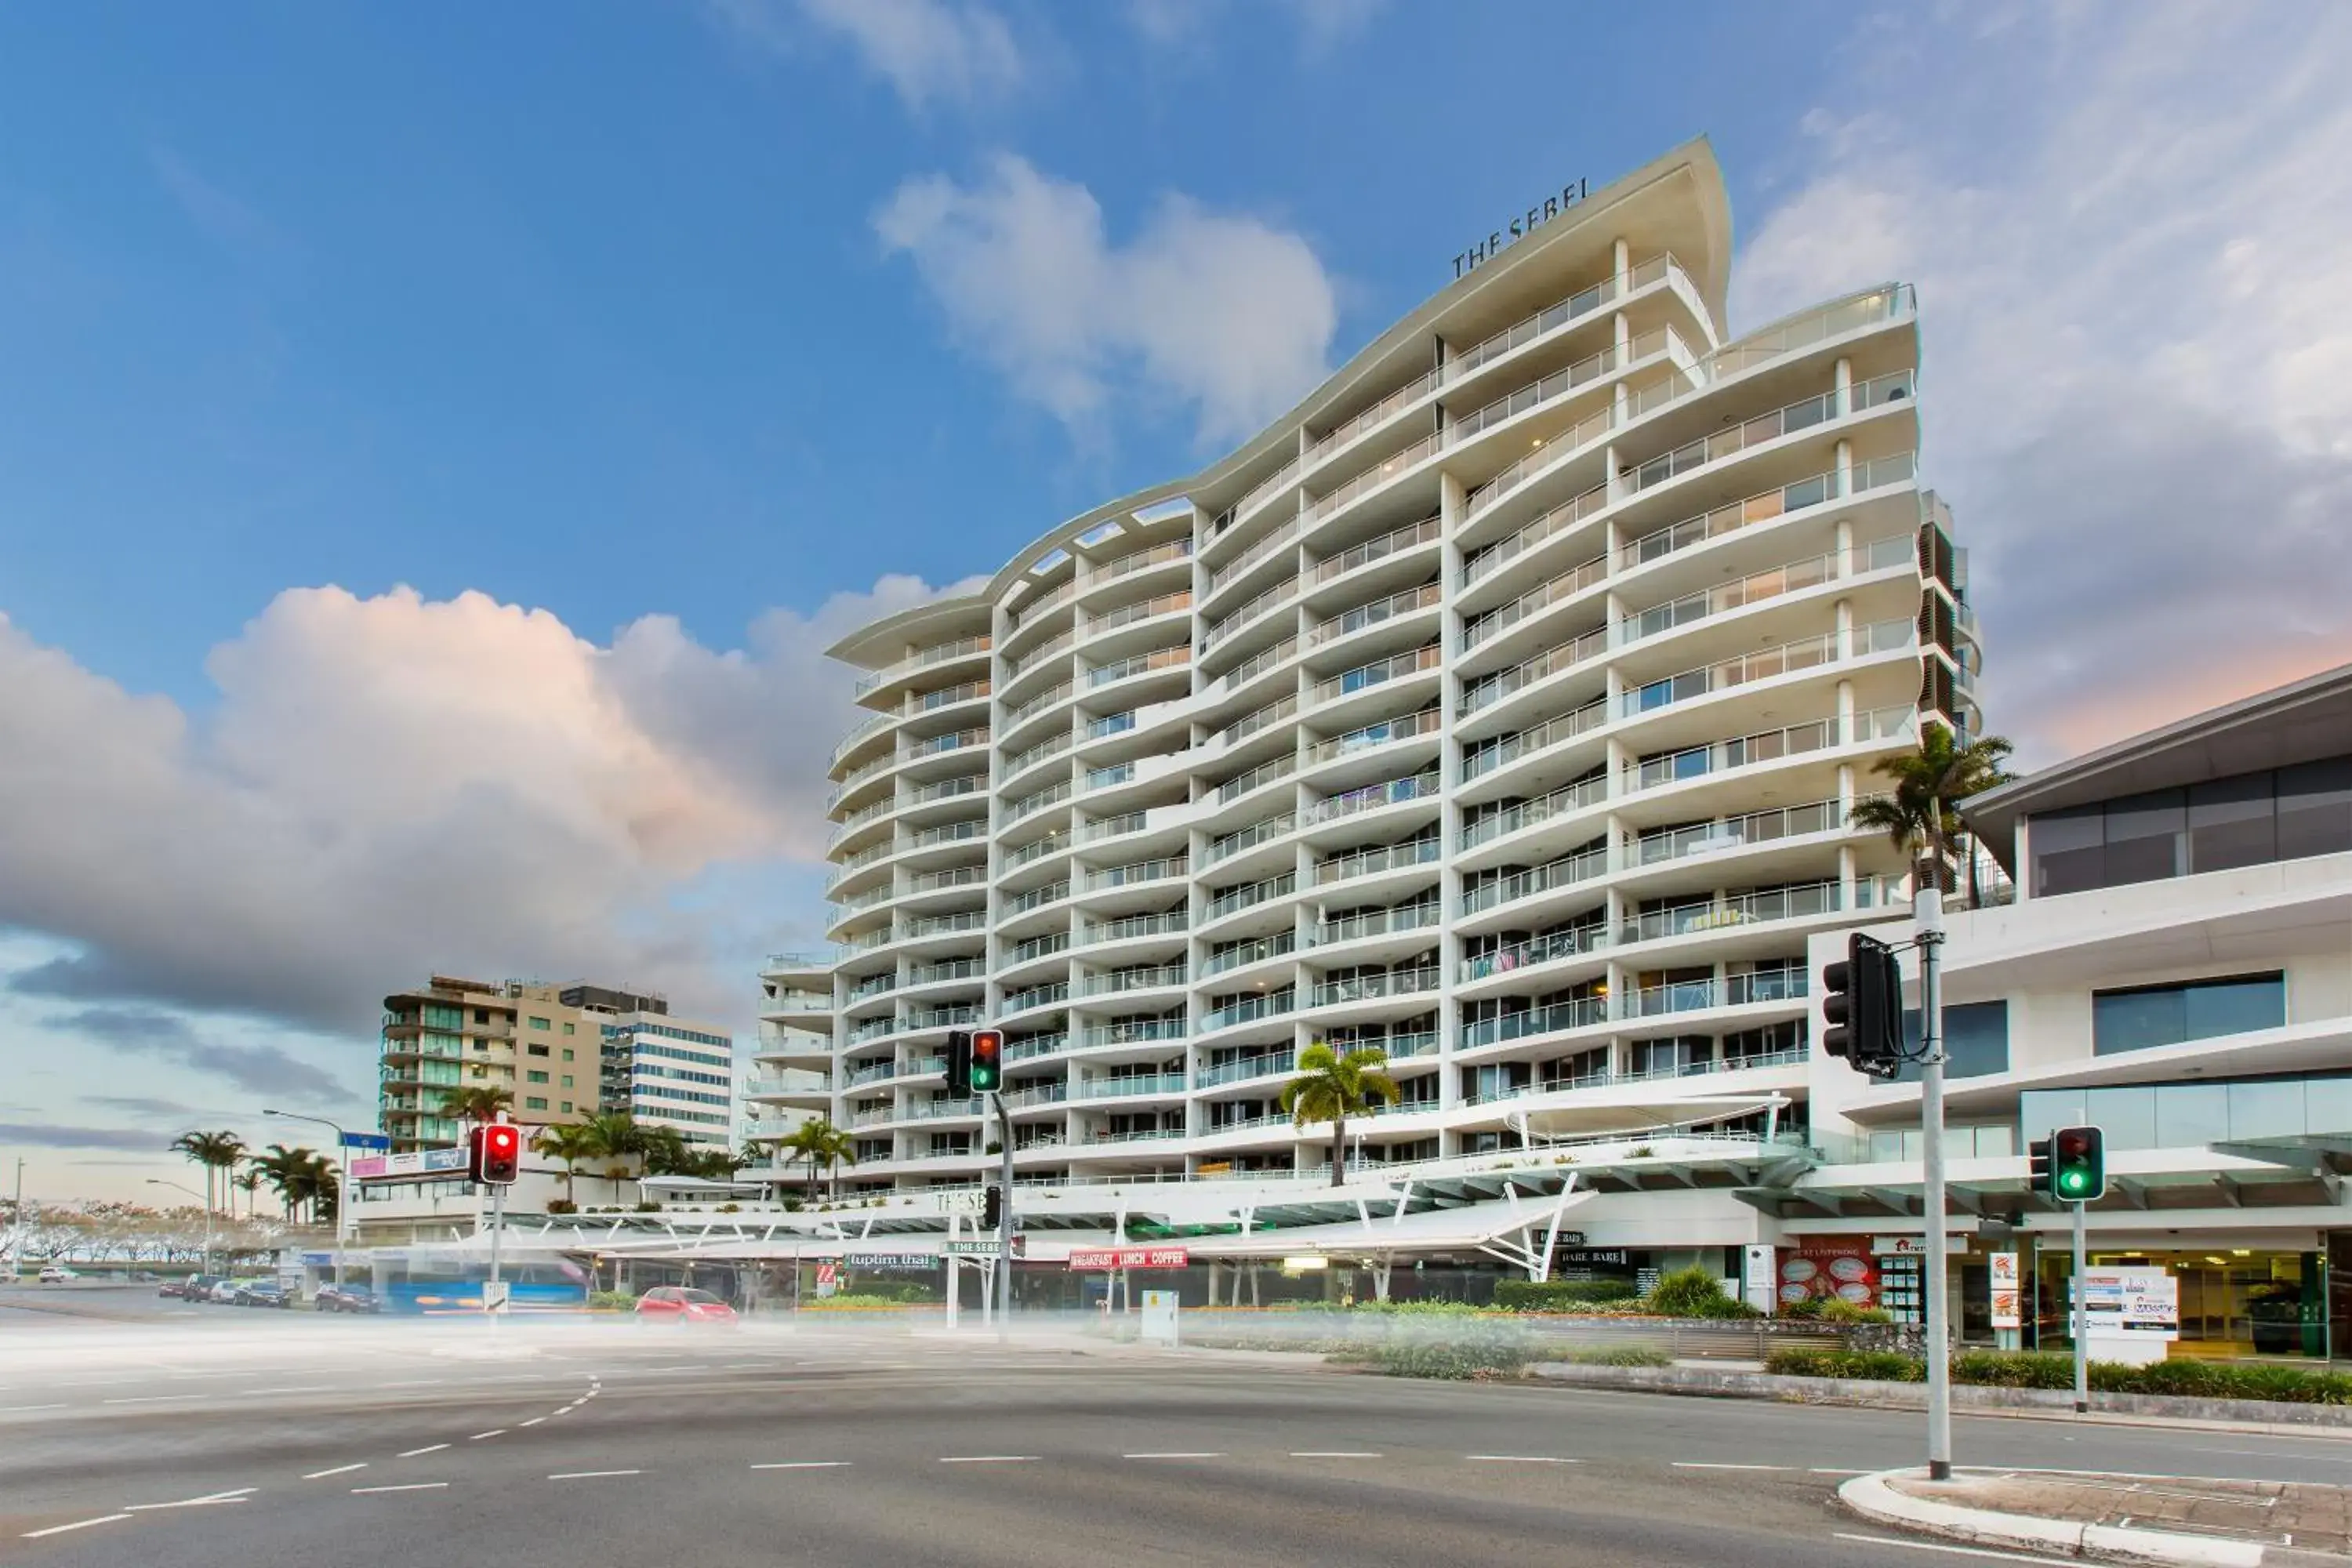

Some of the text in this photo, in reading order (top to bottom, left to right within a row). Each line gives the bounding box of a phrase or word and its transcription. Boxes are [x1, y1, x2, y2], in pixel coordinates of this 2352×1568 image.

[953, 1243, 1000, 1252] THE SEBE
[1070, 1250, 1184, 1266] BREAKFAST LUNCH COFFEE
